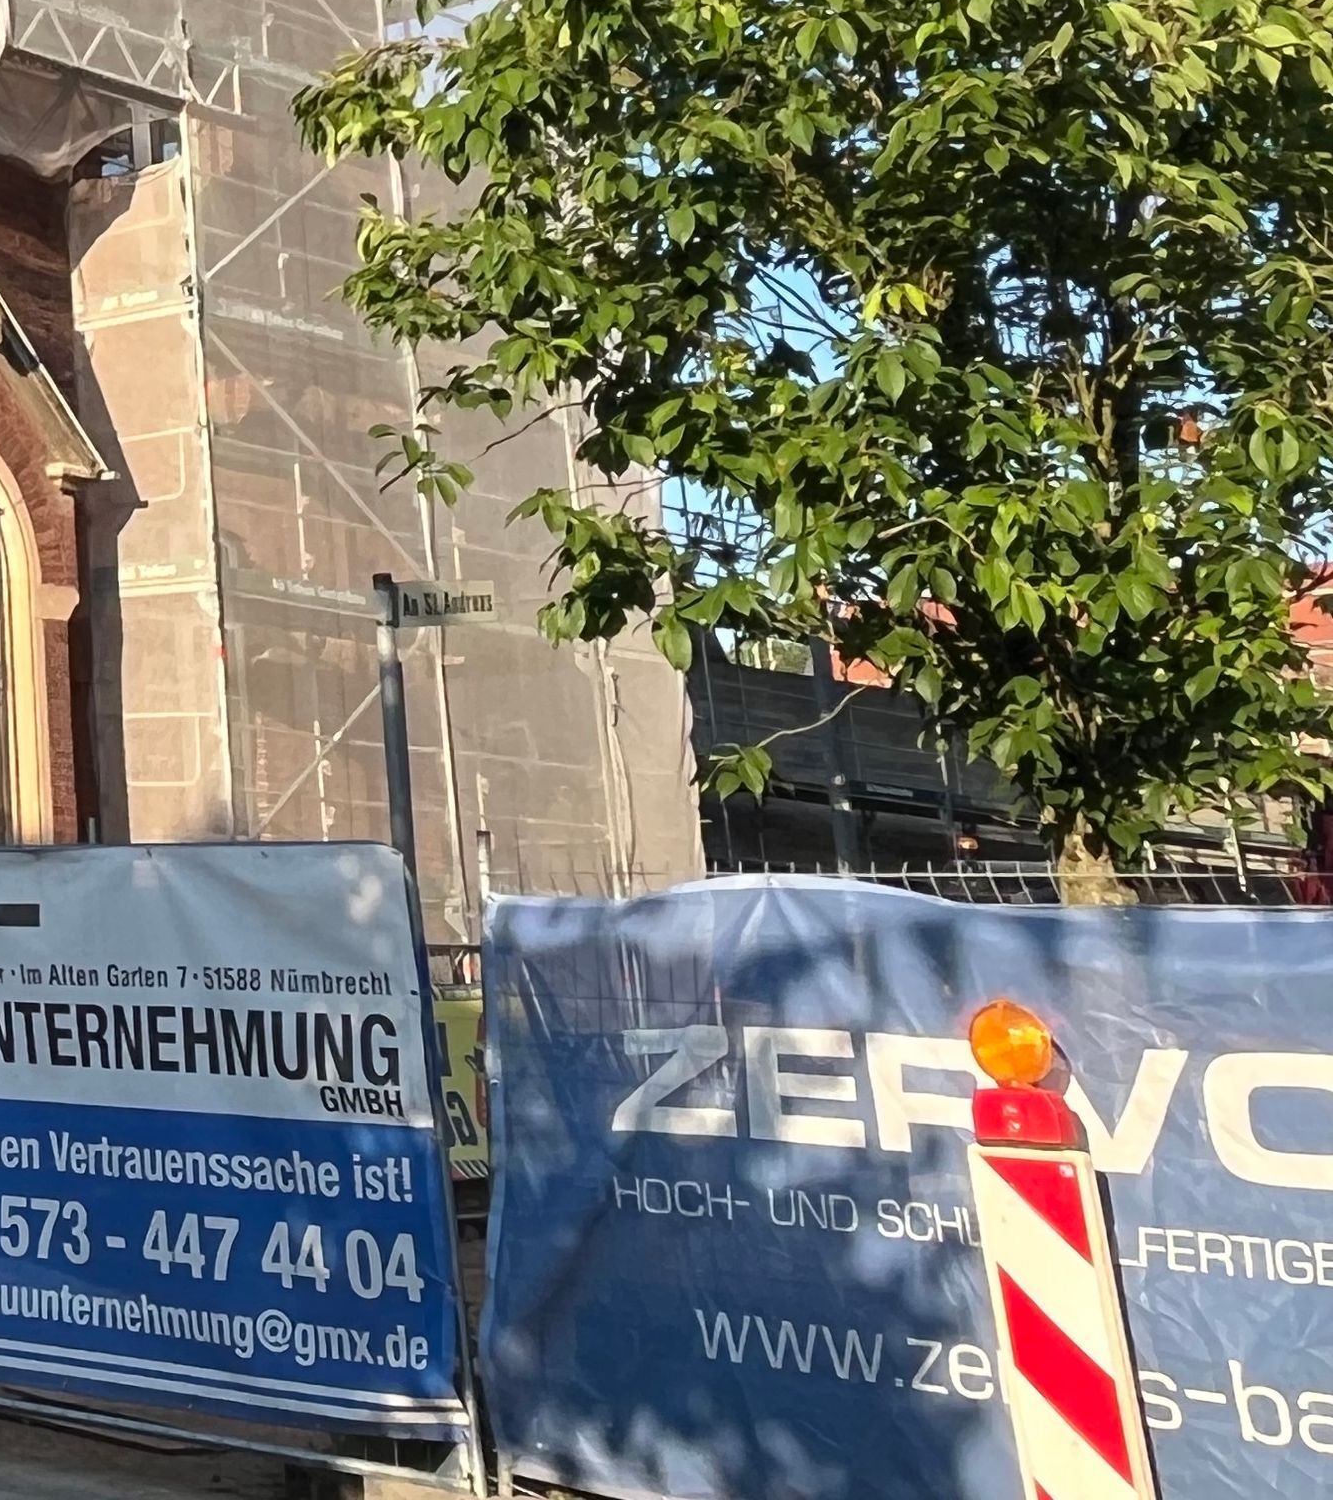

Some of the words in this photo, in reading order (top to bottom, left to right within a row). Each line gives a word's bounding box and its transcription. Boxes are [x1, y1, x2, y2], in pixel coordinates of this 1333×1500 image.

[20, 964, 42, 985] Im
[49, 964, 99, 987] Alten
[107, 963, 169, 989] Garten
[177, 966, 188, 988] 7
[203, 968, 262, 992] 51588
[270, 968, 393, 997] Nümbrecht
[319, 1085, 404, 1119] GMBH
[48, 1131, 340, 1198] Vertrauenssache
[352, 1153, 413, 1203] ist!
[613, 1176, 750, 1220] HOCH-
[768, 1187, 858, 1232] UND
[142, 1209, 240, 1282] 447
[261, 1220, 331, 1294] 44
[345, 1228, 426, 1303] 04
